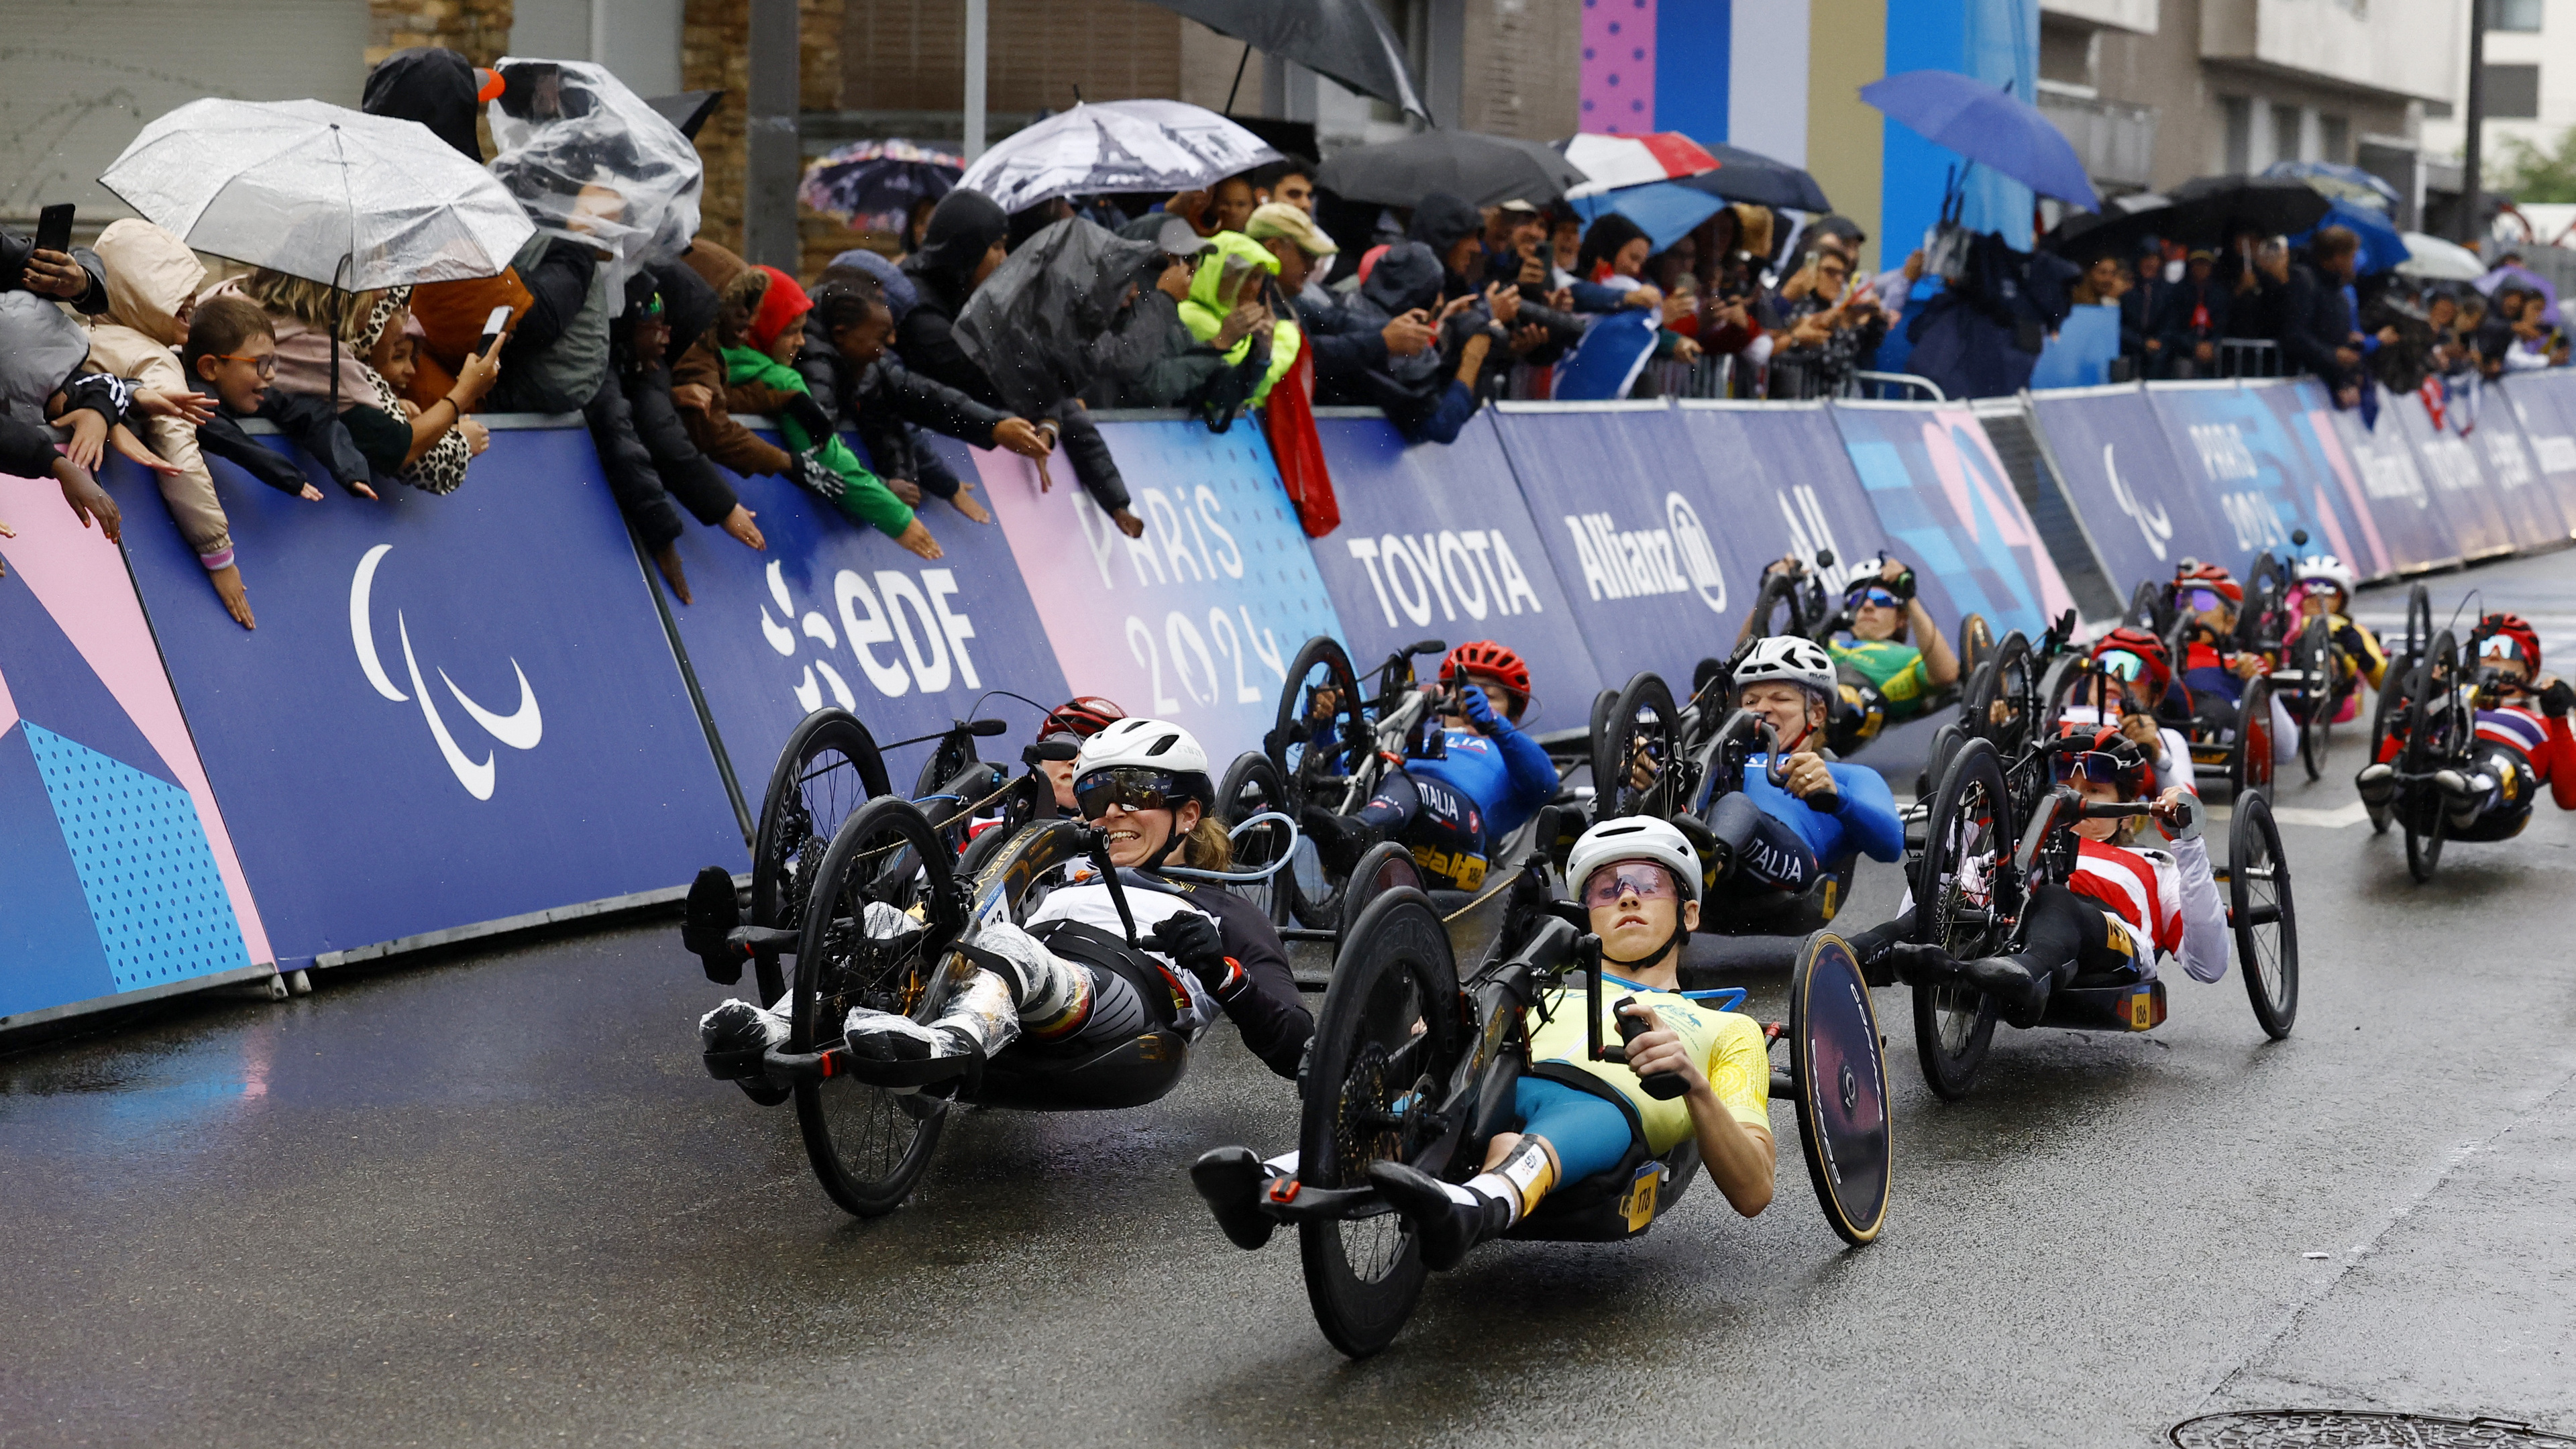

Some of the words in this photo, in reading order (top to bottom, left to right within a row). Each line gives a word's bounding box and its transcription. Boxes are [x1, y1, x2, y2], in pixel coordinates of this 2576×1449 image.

[1346, 529, 1543, 628] TOYOTA
[1564, 512, 1689, 601] Allianz
[1126, 605, 1288, 715] 2024
[1809, 672, 1831, 681] RUDY
[1417, 782, 1459, 821] ITALIA
[1739, 837, 1802, 883] ITALIA
[2136, 1004, 2147, 1025] 186
[1849, 983, 1883, 1122] CORIMA
[1811, 1038, 1841, 1185] CORIMA
[1637, 1185, 1652, 1214] 178
